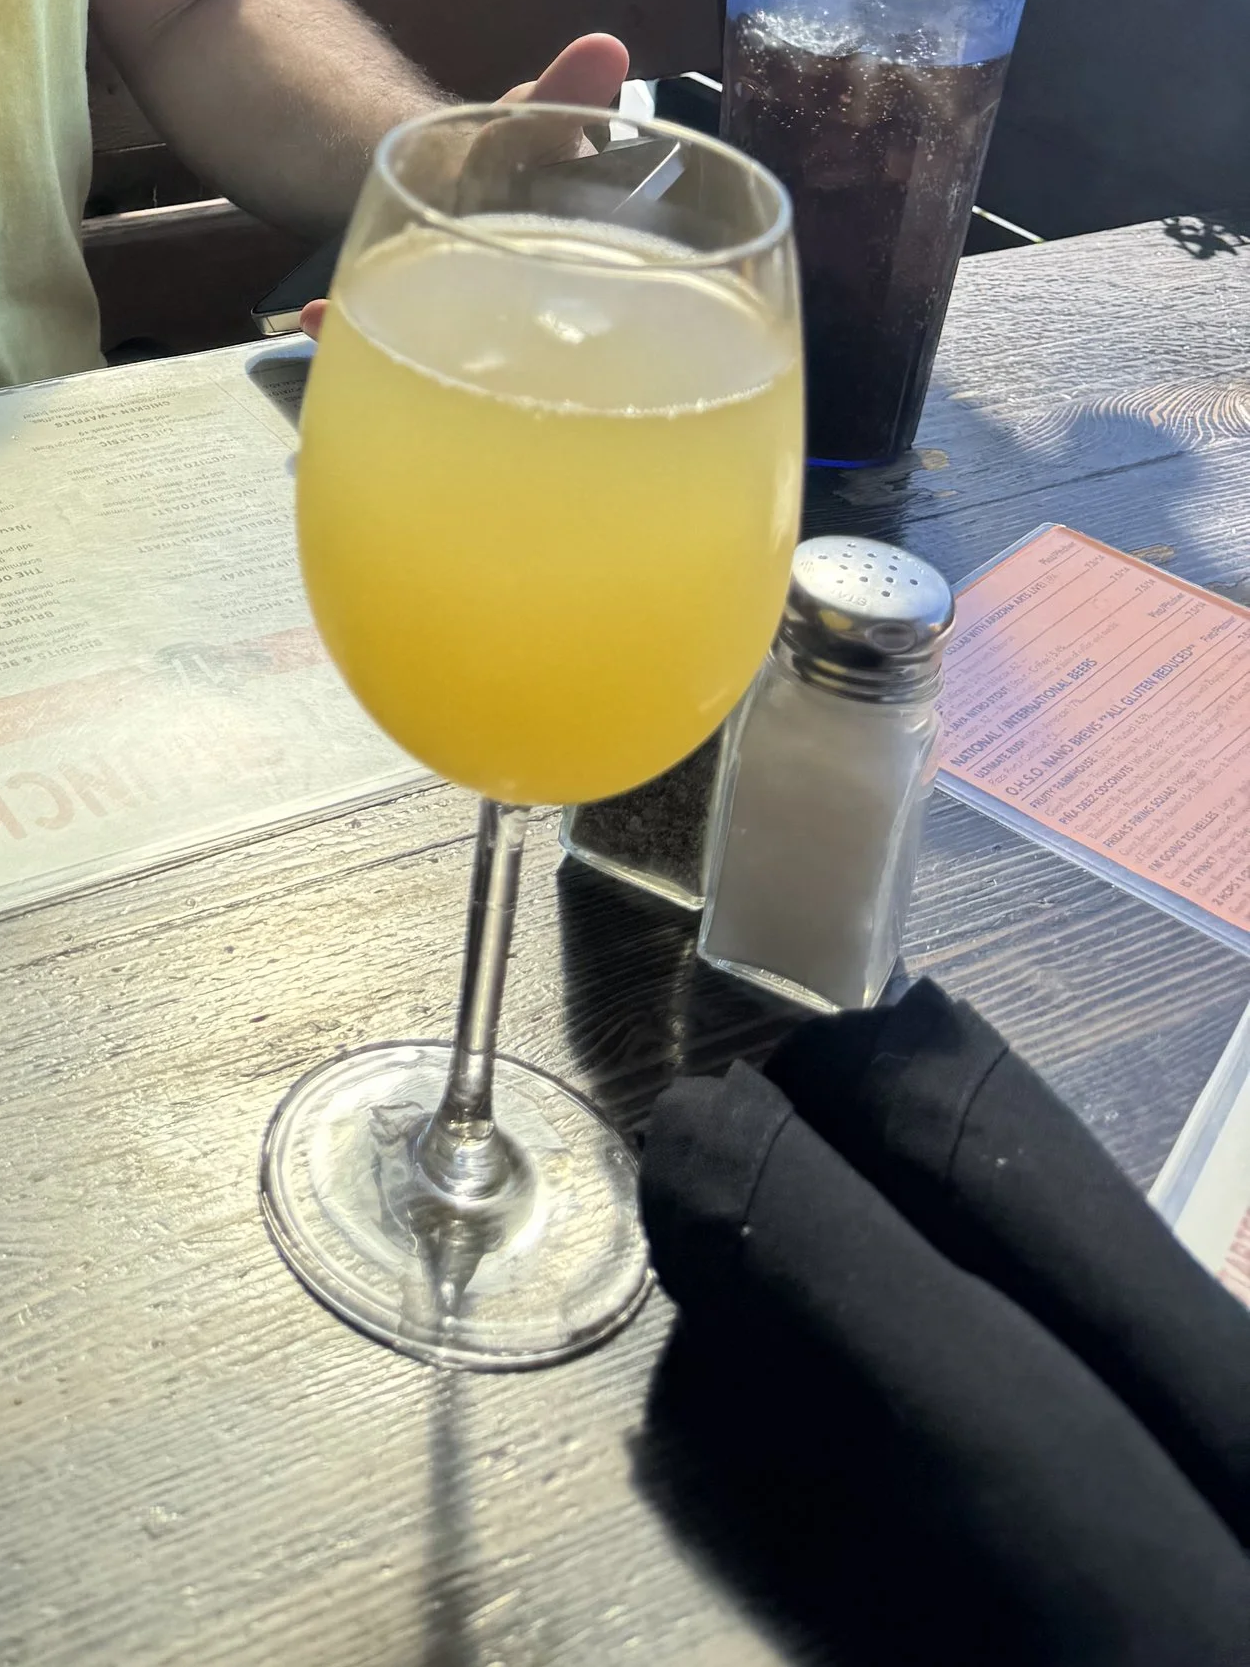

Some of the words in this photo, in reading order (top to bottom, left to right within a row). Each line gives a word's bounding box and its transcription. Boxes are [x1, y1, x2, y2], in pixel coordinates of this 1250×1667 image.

[14, 566, 43, 578] THE
[941, 635, 972, 655] COLLAB
[966, 622, 989, 637] WITH
[984, 602, 1017, 624] ARIZONA
[1011, 592, 1032, 605] ARTS
[35, 638, 104, 660] BISCUITS
[947, 716, 971, 731] JAVA
[965, 701, 991, 718] NITRO
[985, 686, 1012, 703] STOUT
[948, 729, 1003, 767] NATIONAL
[999, 676, 1073, 729] INTERNATIONAL
[1065, 657, 1099, 680] BEERS
[1039, 743, 1075, 768] NANO
[1067, 720, 1104, 746] BREWS
[1118, 677, 1159, 706] GLUTEN
[972, 752, 1011, 779] ULTIMATE
[1004, 738, 1030, 755] RUSH
[1027, 787, 1058, 809] FRUITY
[1051, 755, 1099, 790] FARMHOUSE
[1073, 793, 1099, 811] DEEZ
[1092, 764, 1136, 796] COCONUTS
[1126, 804, 1156, 826] FIRING
[1148, 785, 1179, 808] SQUAD
[1156, 839, 1187, 861] GOING
[1180, 830, 1198, 842] TO
[1190, 810, 1221, 833] HELLES
